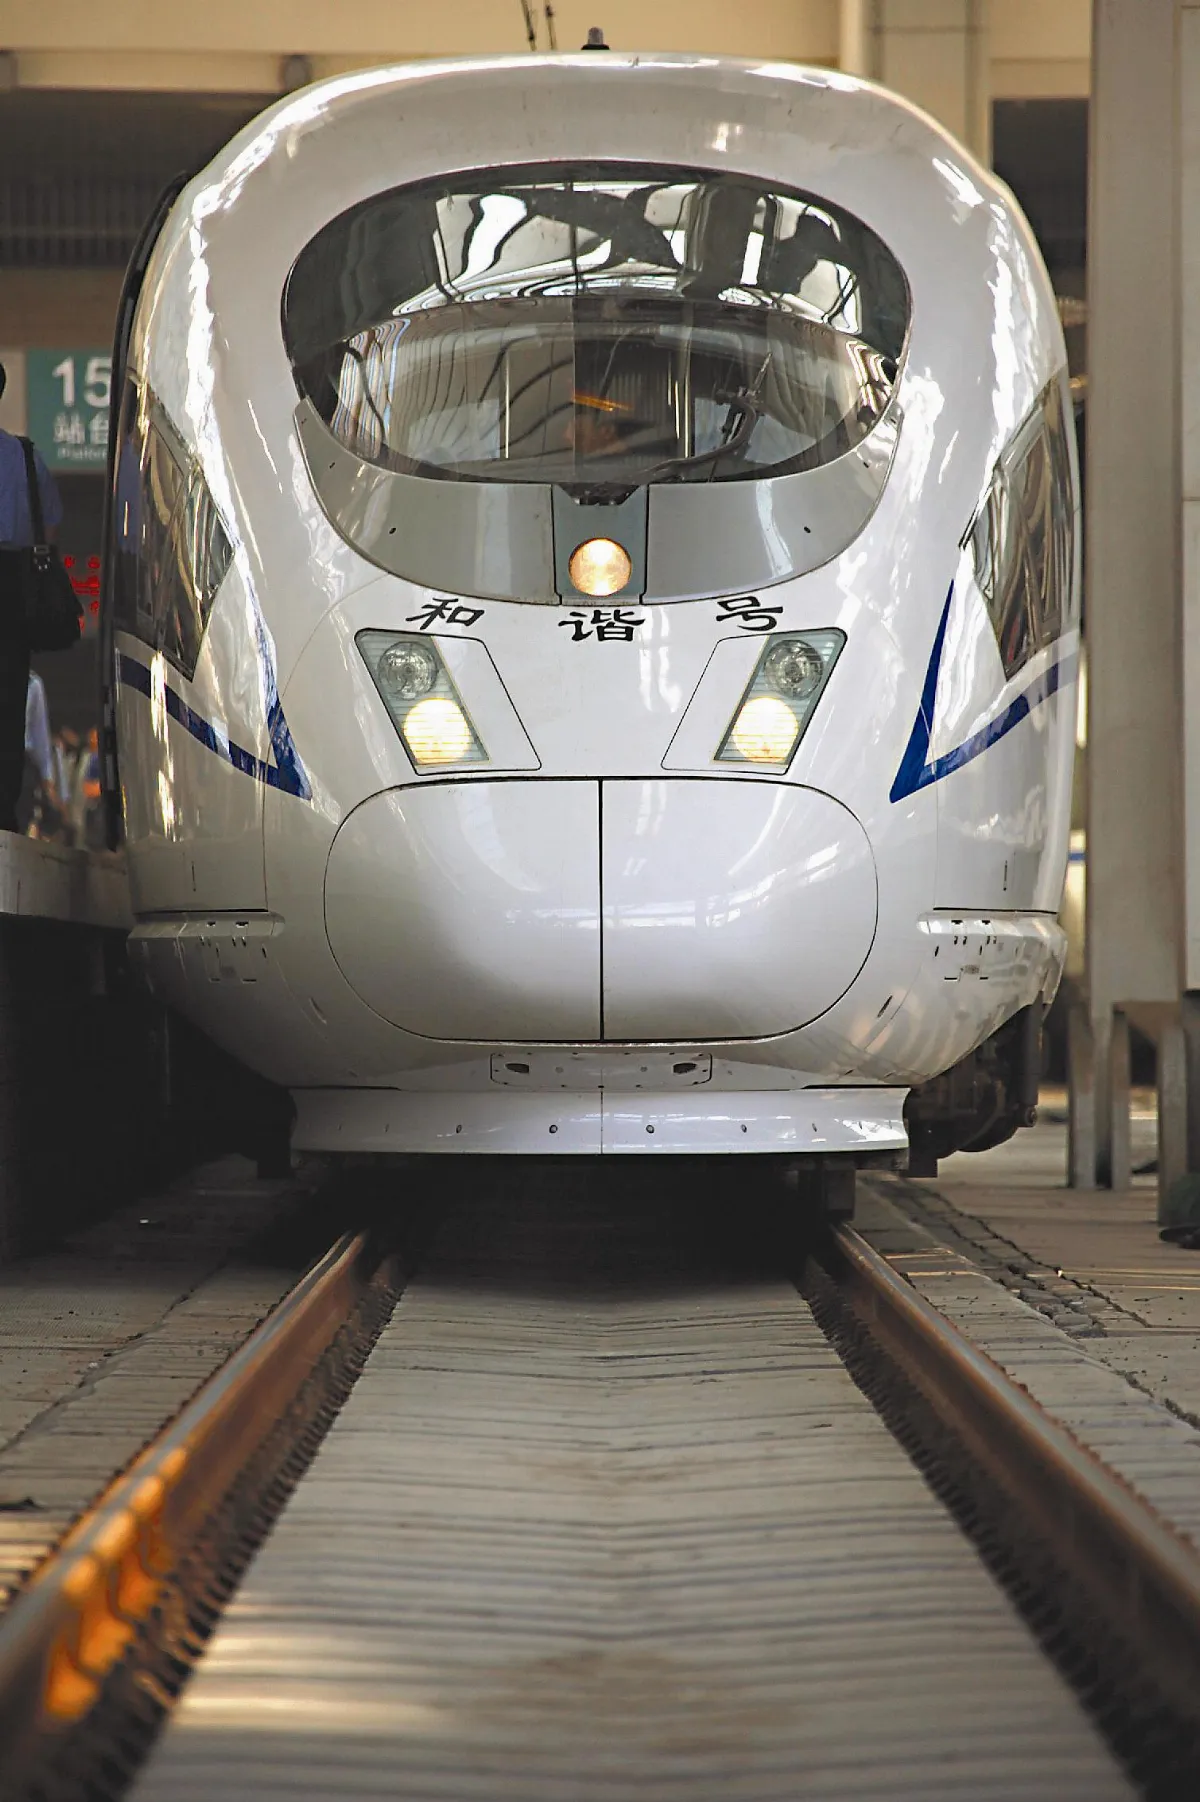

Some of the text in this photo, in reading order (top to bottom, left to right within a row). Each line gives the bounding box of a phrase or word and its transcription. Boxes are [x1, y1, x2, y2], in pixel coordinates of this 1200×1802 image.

[52, 356, 112, 408] 15
[405, 596, 784, 642] 和谐号
